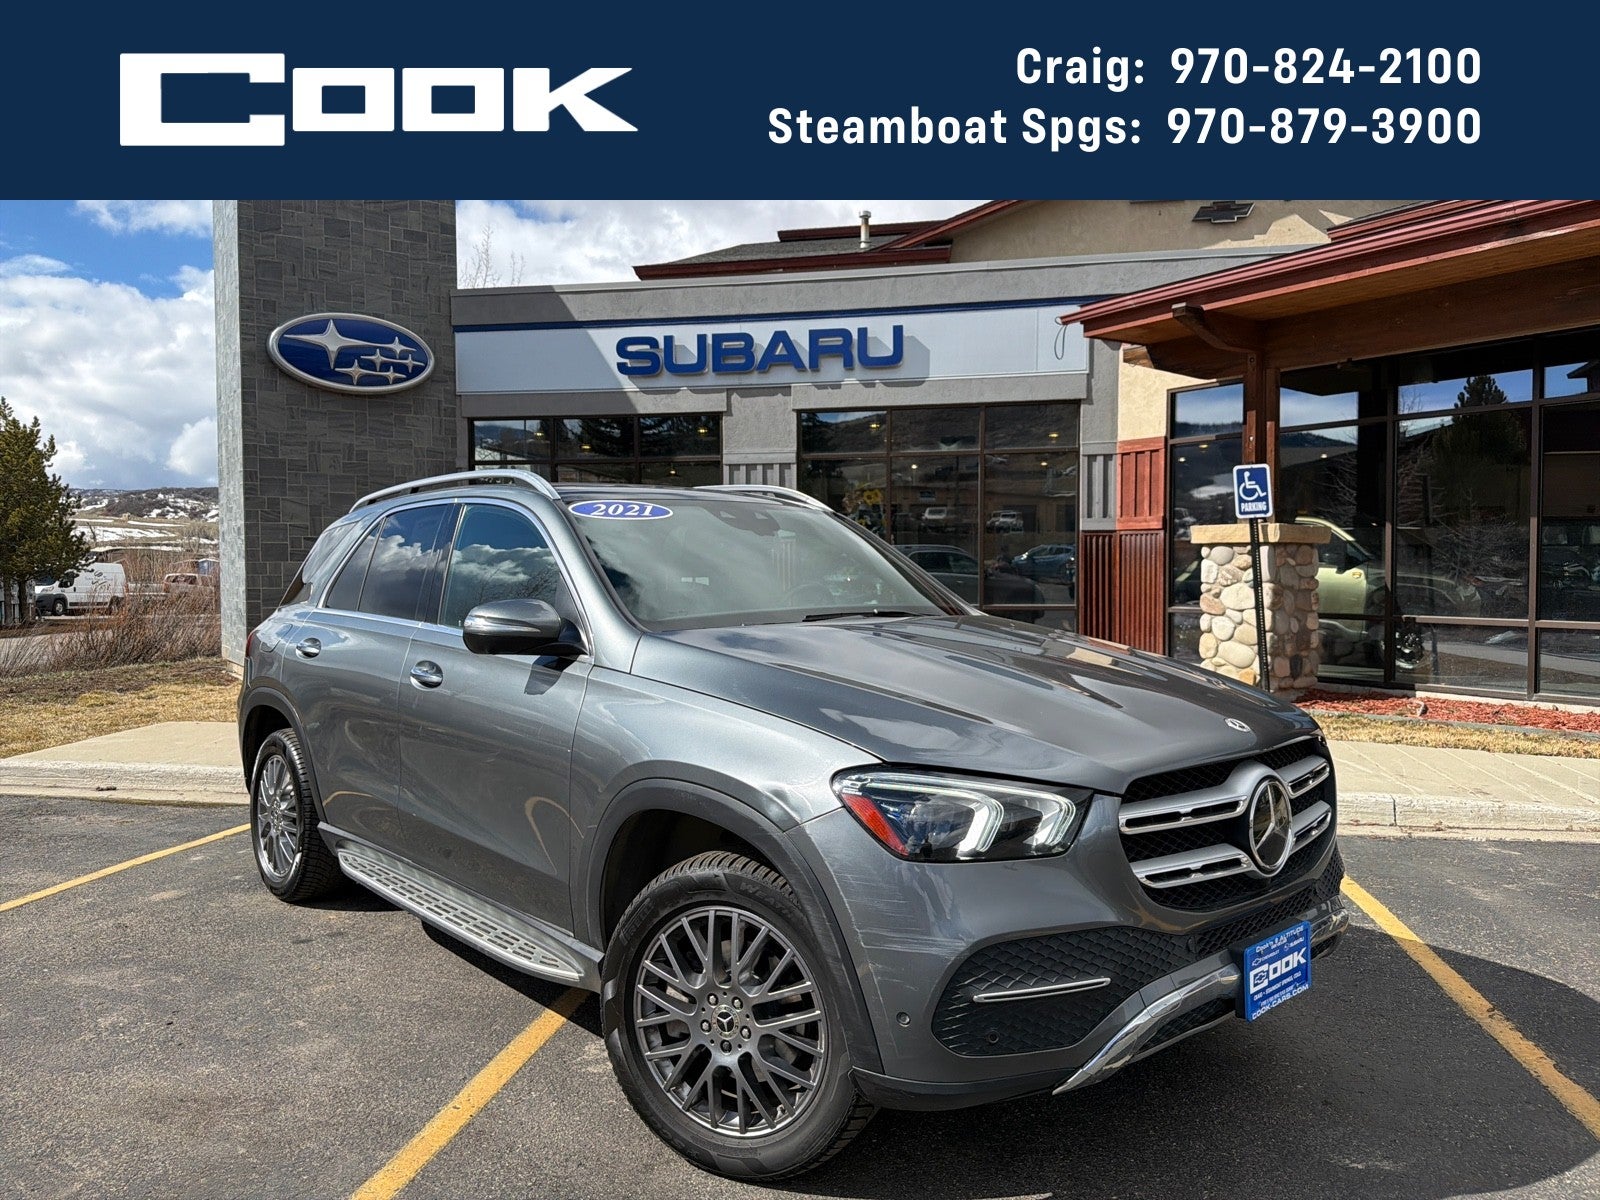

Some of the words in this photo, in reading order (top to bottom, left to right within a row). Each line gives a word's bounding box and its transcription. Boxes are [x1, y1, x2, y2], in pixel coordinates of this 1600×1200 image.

[616, 325, 904, 377] SUBARU
[590, 503, 654, 516] 2021
[1240, 501, 1267, 512] PARKING
[1252, 984, 1310, 1020] COOK-CARS.COM
